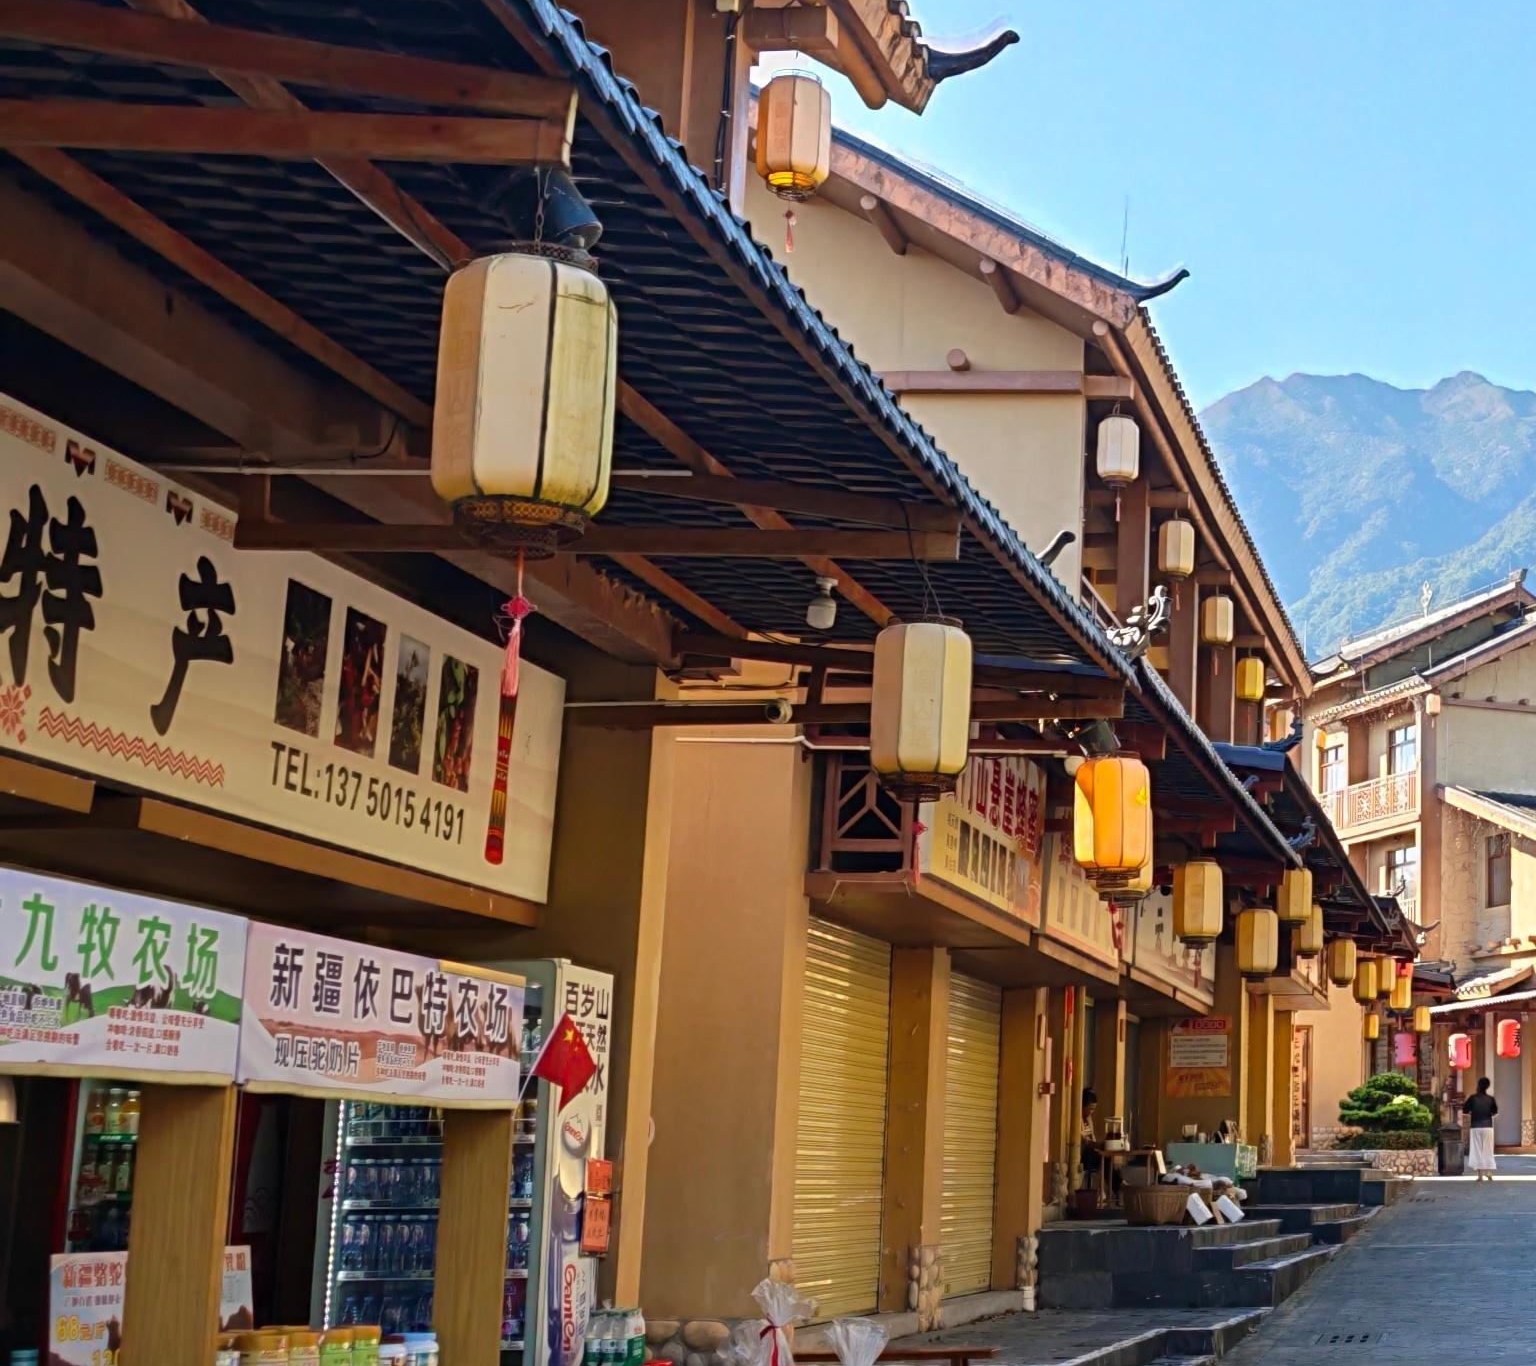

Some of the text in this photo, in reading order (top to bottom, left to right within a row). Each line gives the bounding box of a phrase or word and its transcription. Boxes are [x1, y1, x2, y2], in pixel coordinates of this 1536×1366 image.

[0, 484, 235, 736] 特产
[0, 892, 219, 993] 九牧农场
[271, 943, 509, 1042] 新疆依巴特农场
[565, 981, 609, 1019] 百岁山
[275, 1036, 361, 1077] 现压驼奶片
